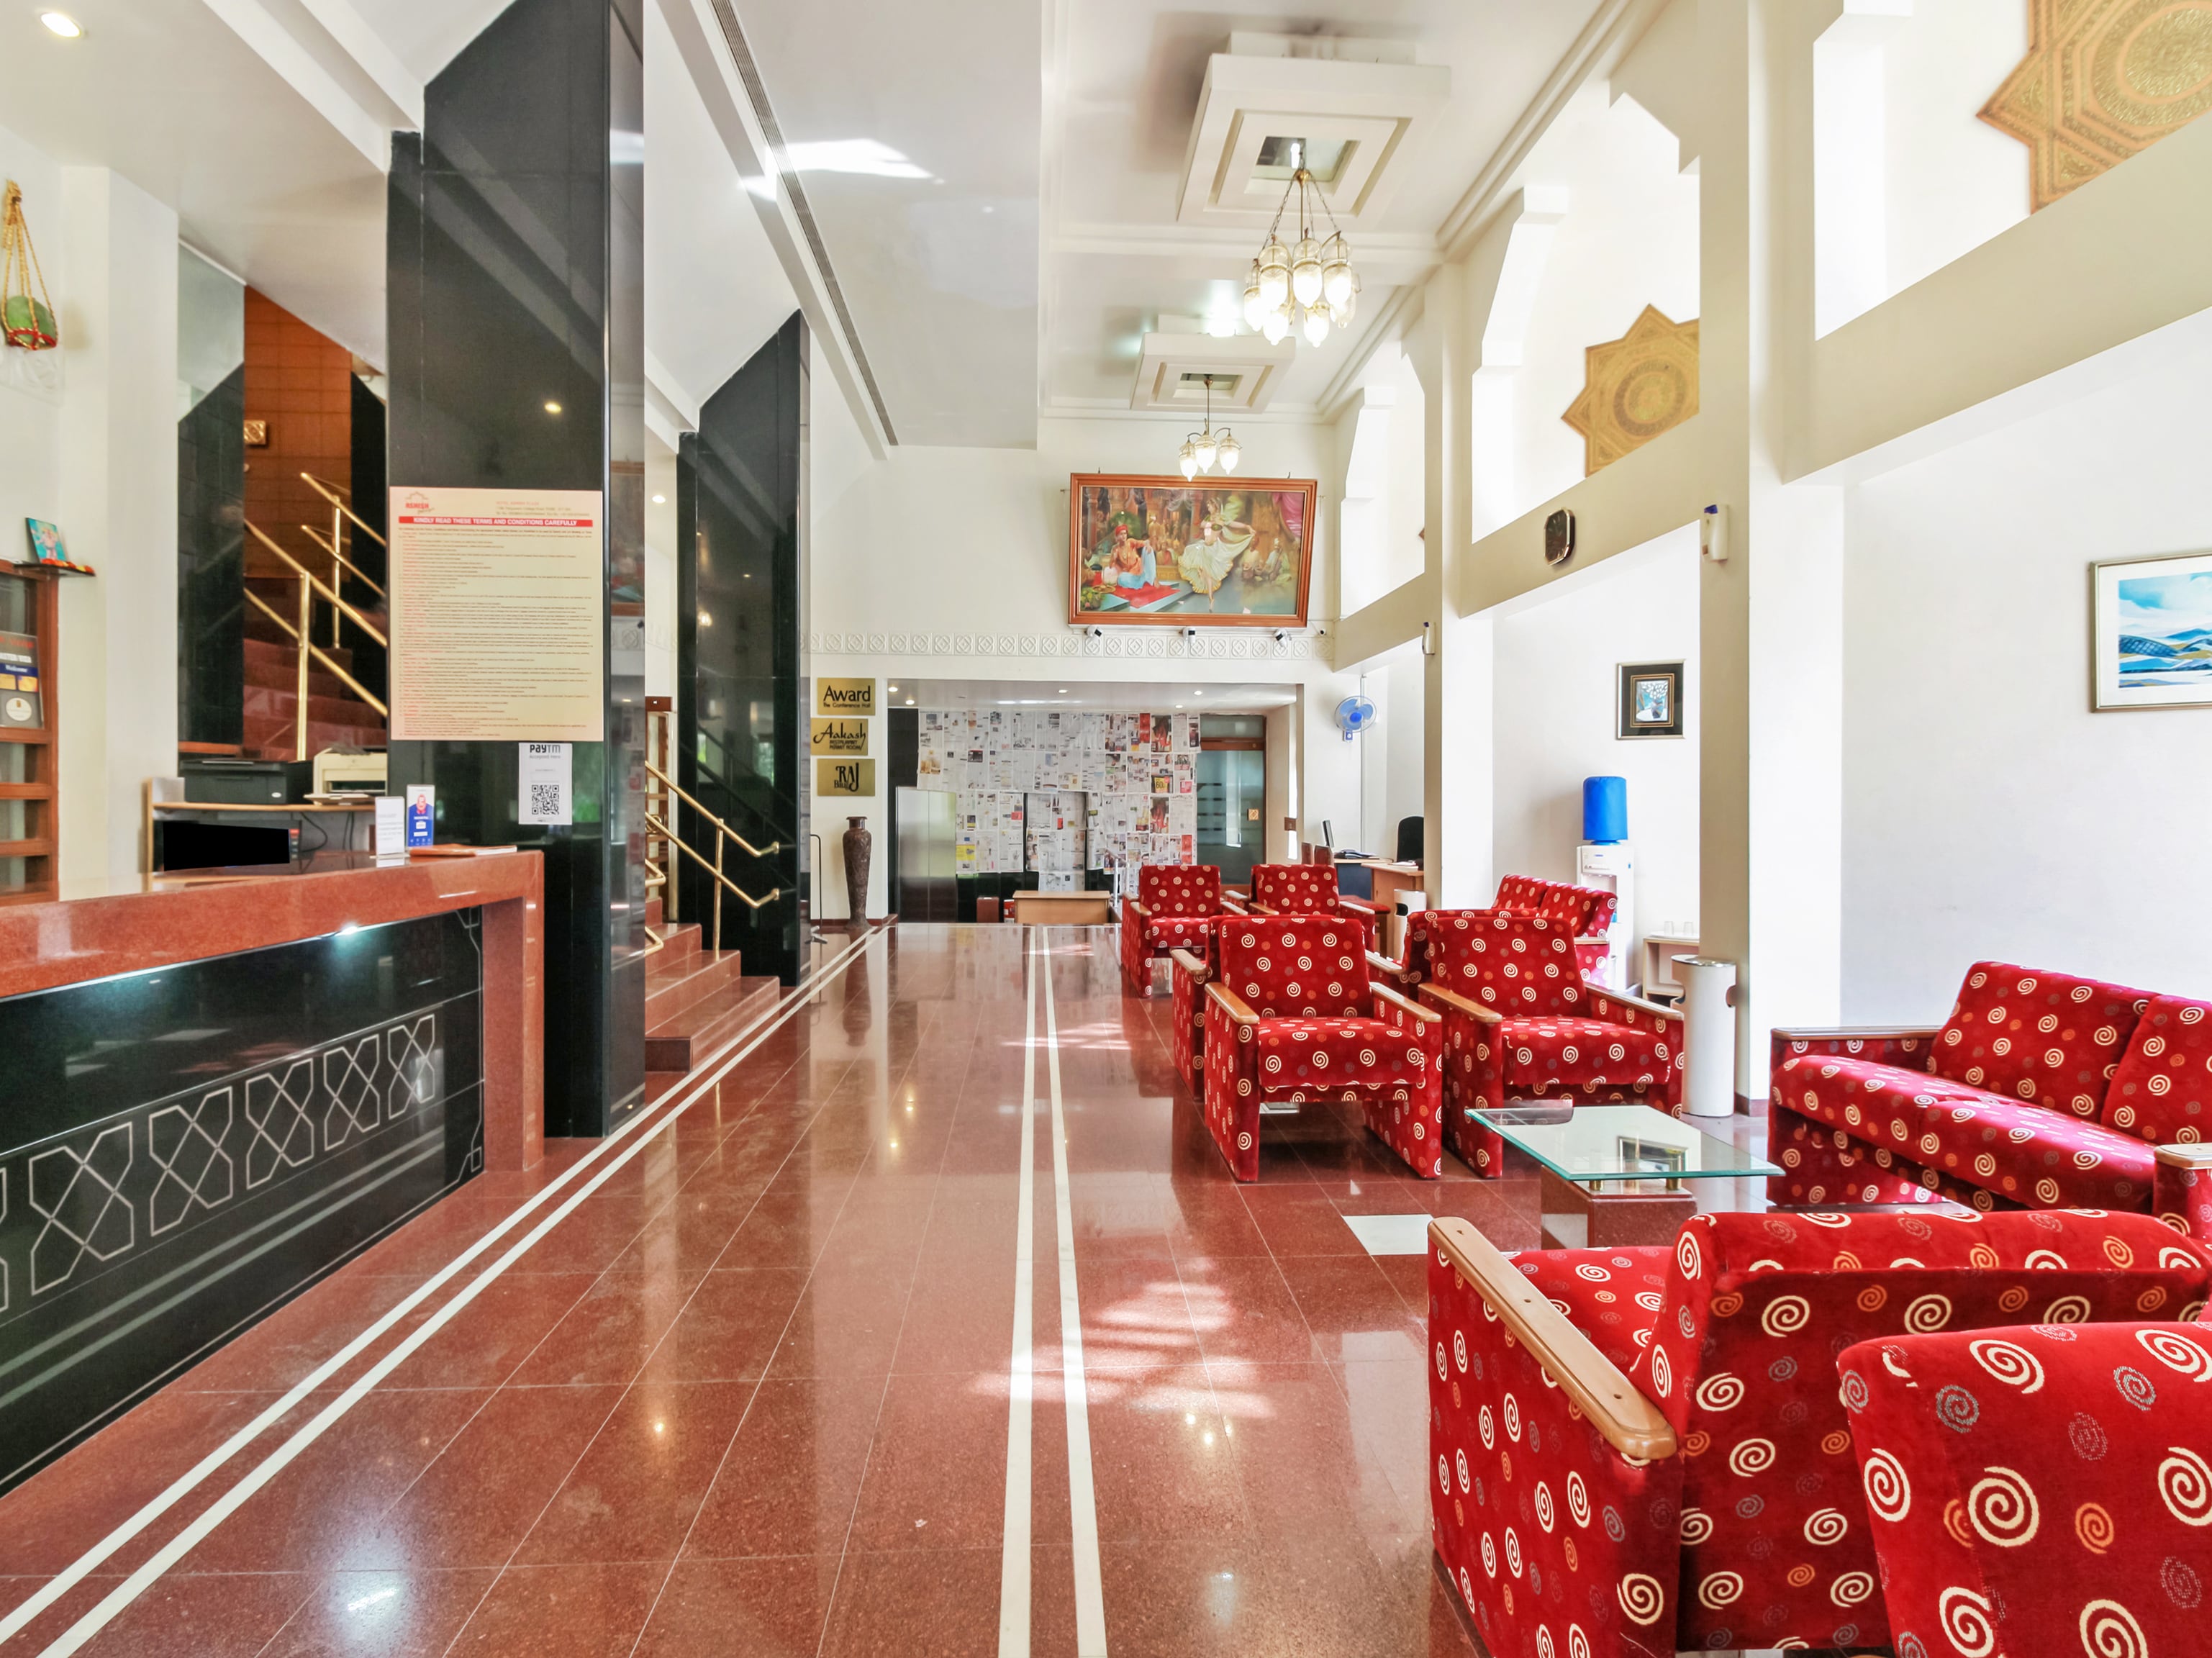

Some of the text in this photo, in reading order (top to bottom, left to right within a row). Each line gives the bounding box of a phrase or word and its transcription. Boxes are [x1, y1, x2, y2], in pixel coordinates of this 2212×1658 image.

[823, 685, 871, 702] Award
[813, 722, 866, 751] Aakash
[835, 761, 859, 792] RAJ
